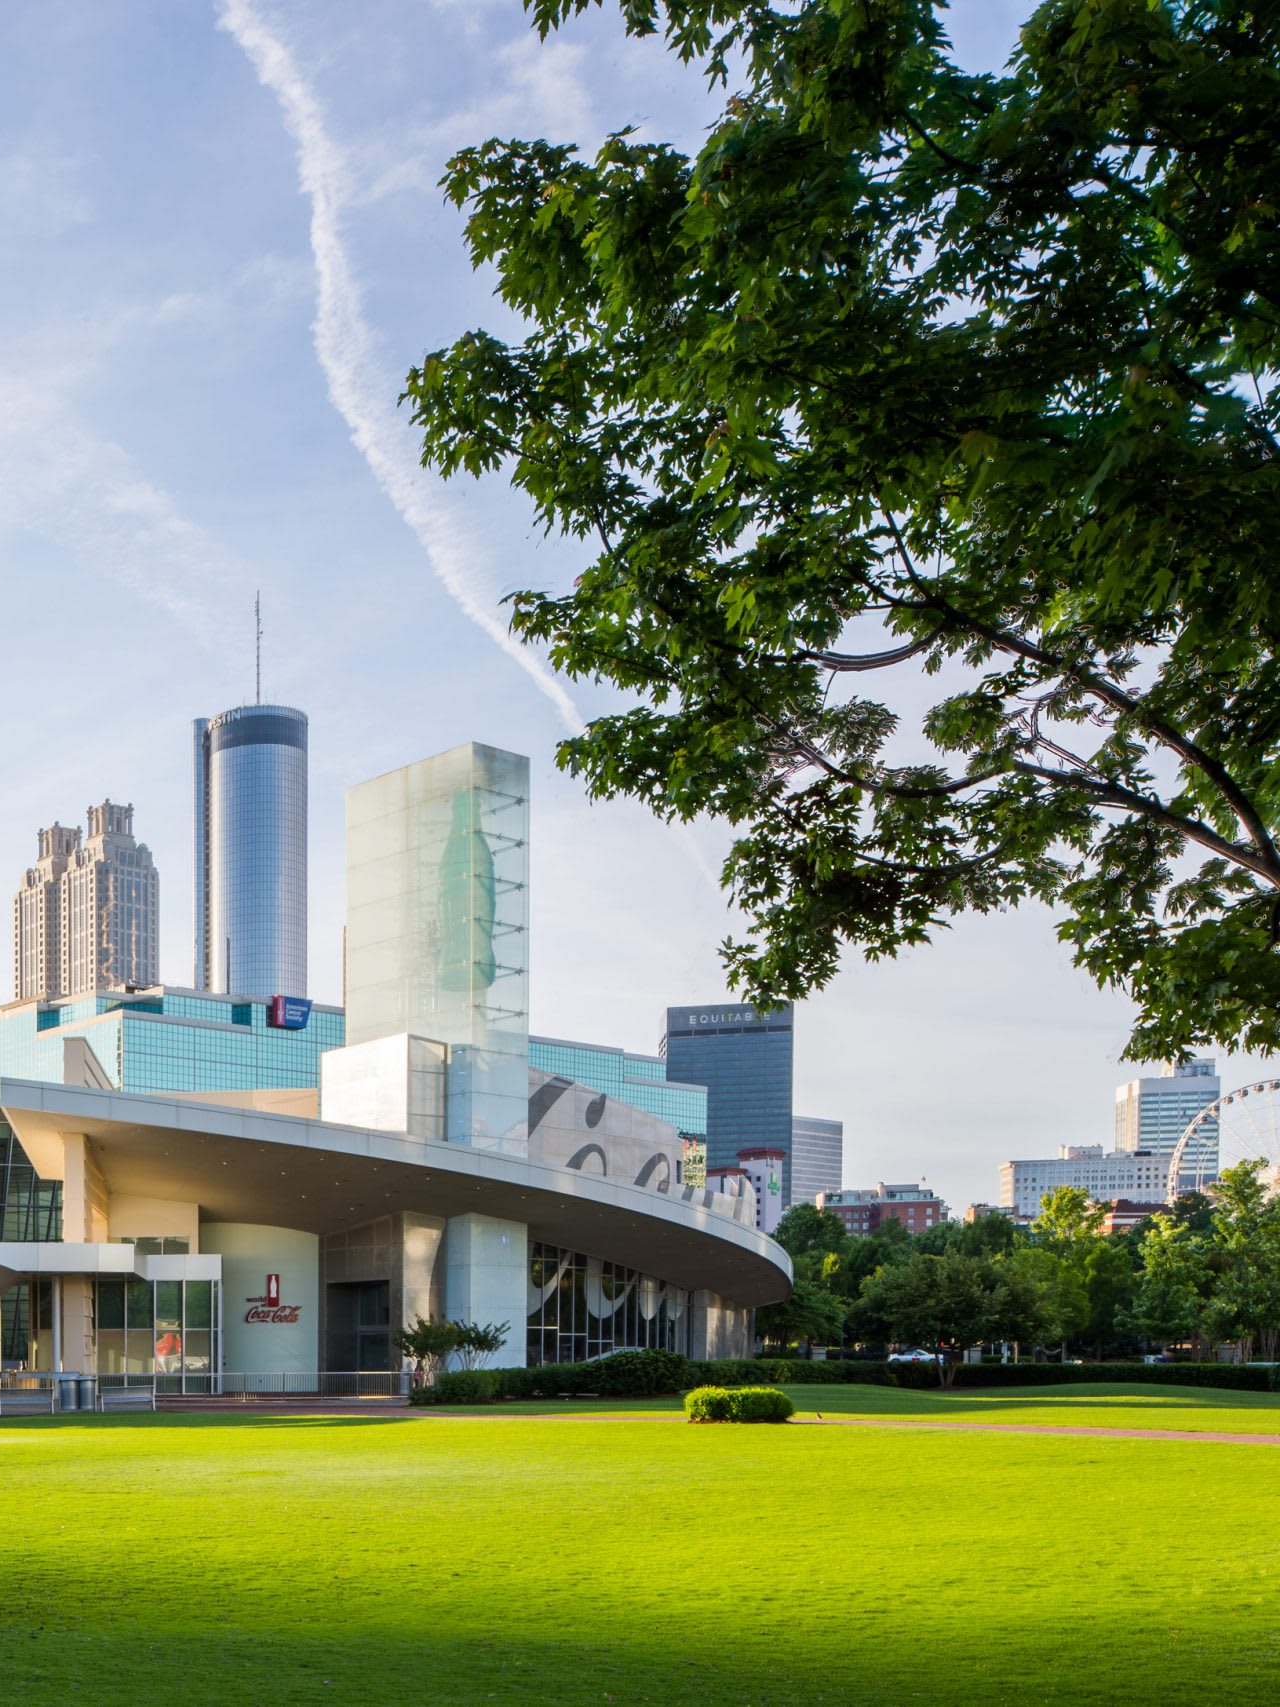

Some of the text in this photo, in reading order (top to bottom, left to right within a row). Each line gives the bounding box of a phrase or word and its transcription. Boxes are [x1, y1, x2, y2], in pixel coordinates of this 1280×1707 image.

[286, 1003, 308, 1012] American
[689, 1011, 771, 1025] EQUITABE
[245, 1305, 303, 1324] Coca-Cola
